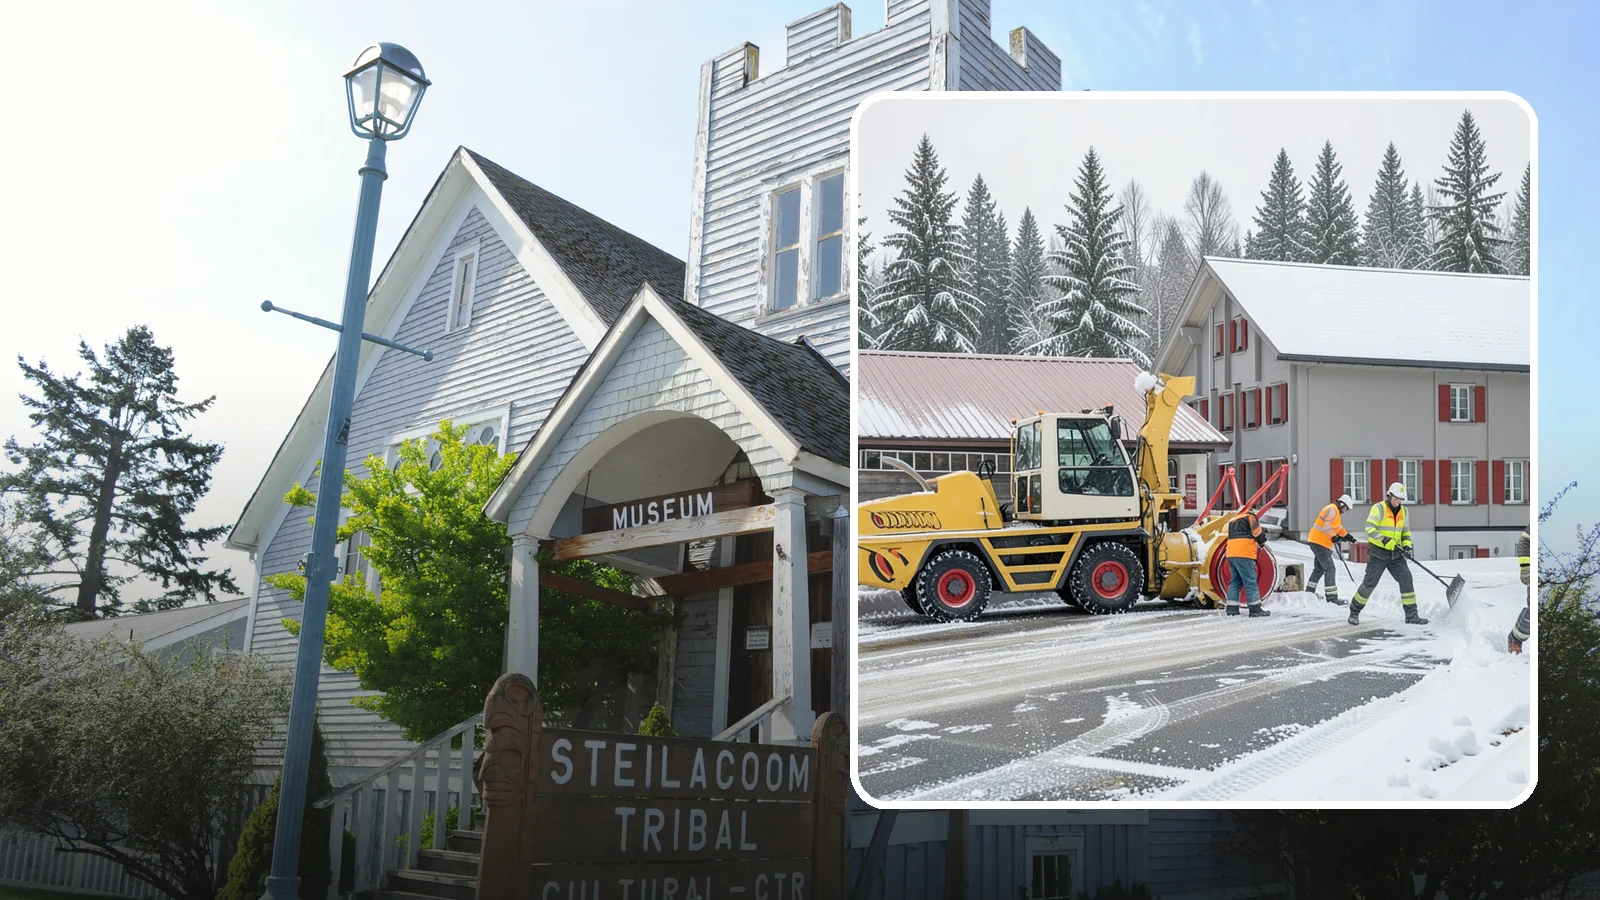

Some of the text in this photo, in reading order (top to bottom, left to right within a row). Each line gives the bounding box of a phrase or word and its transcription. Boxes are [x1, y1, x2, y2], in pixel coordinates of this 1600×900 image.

[612, 491, 714, 531] MUSEUM
[550, 738, 810, 793] STEILACOOM
[614, 806, 758, 853] TRIBAL
